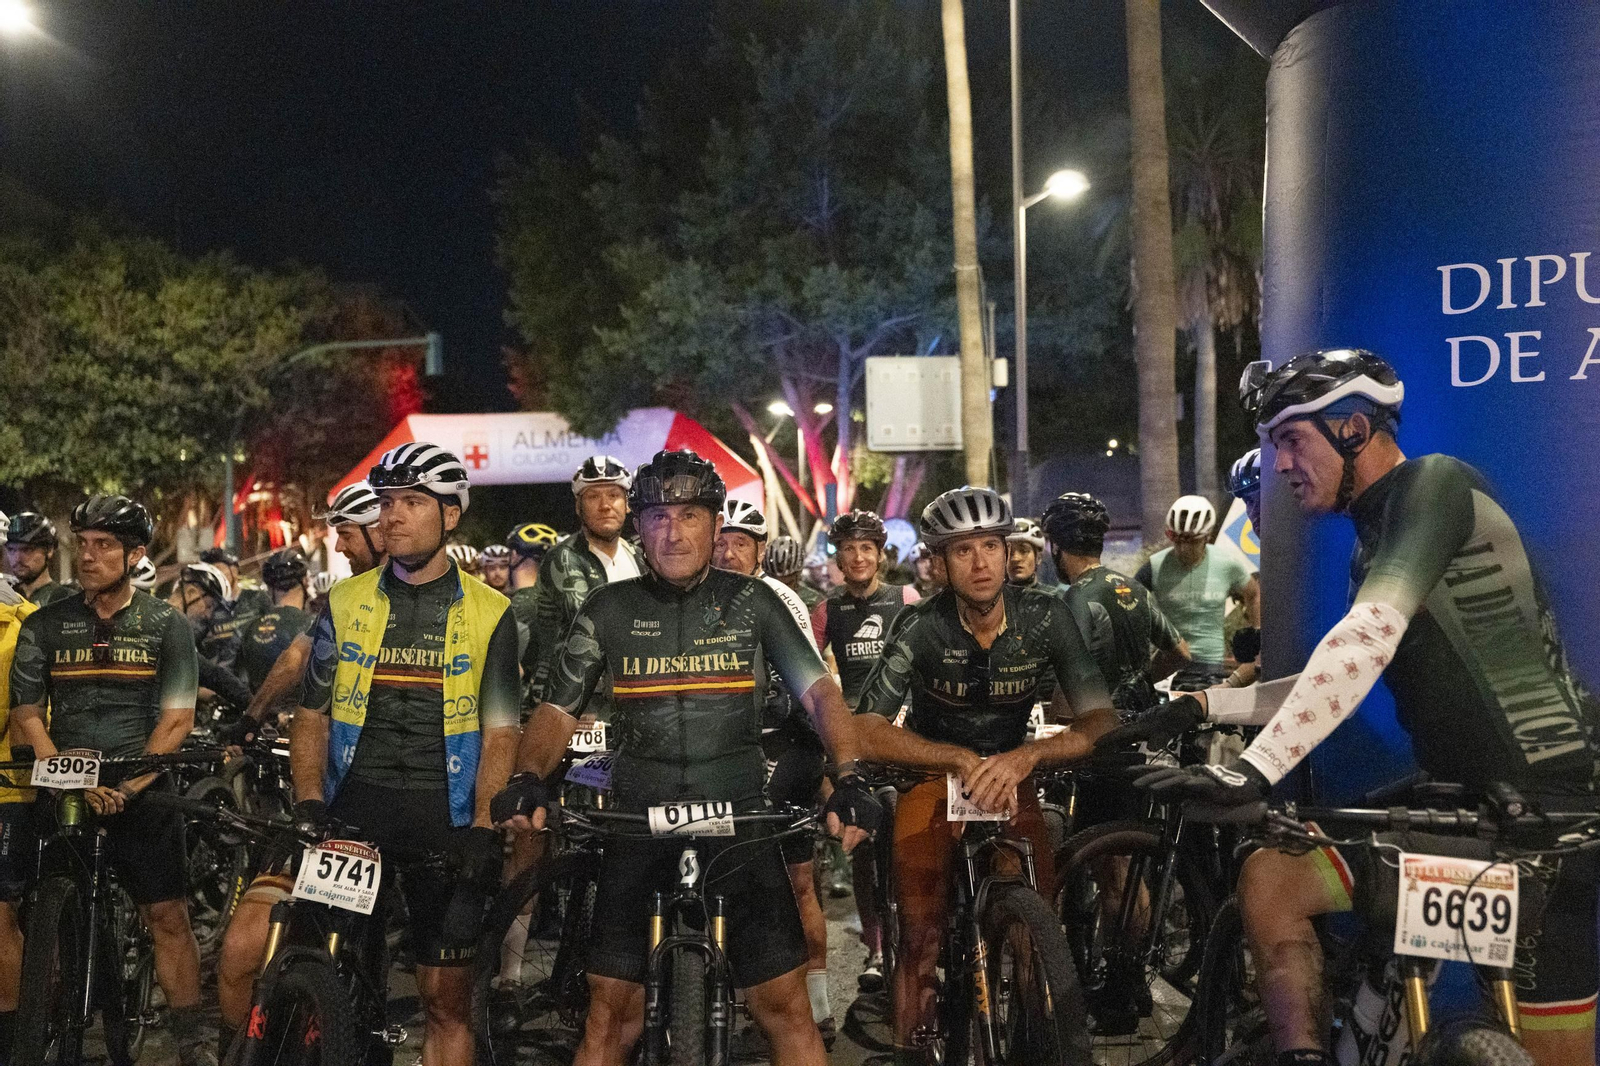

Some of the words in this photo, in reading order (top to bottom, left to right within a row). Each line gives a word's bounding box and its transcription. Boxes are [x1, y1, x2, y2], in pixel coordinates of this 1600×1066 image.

[1437, 252, 1600, 315] DIPU
[1445, 331, 1545, 387] DE
[423, 633, 433, 641] VII
[706, 634, 737, 644] EDICIÓN
[55, 650, 71, 663] LA
[622, 656, 641, 675] LA
[645, 652, 740, 675] DESÉRTICA
[1010, 662, 1037, 673] EDICIÓN
[933, 678, 952, 694] LA
[47, 757, 97, 775] 5902
[664, 801, 727, 825] 6110
[334, 843, 376, 859] DESÉRTICA
[317, 852, 376, 889] 5741
[318, 889, 356, 903] cajamar
[1423, 887, 1511, 935] 6639
[440, 948, 456, 960] LA
[1431, 940, 1484, 954] cajamar
